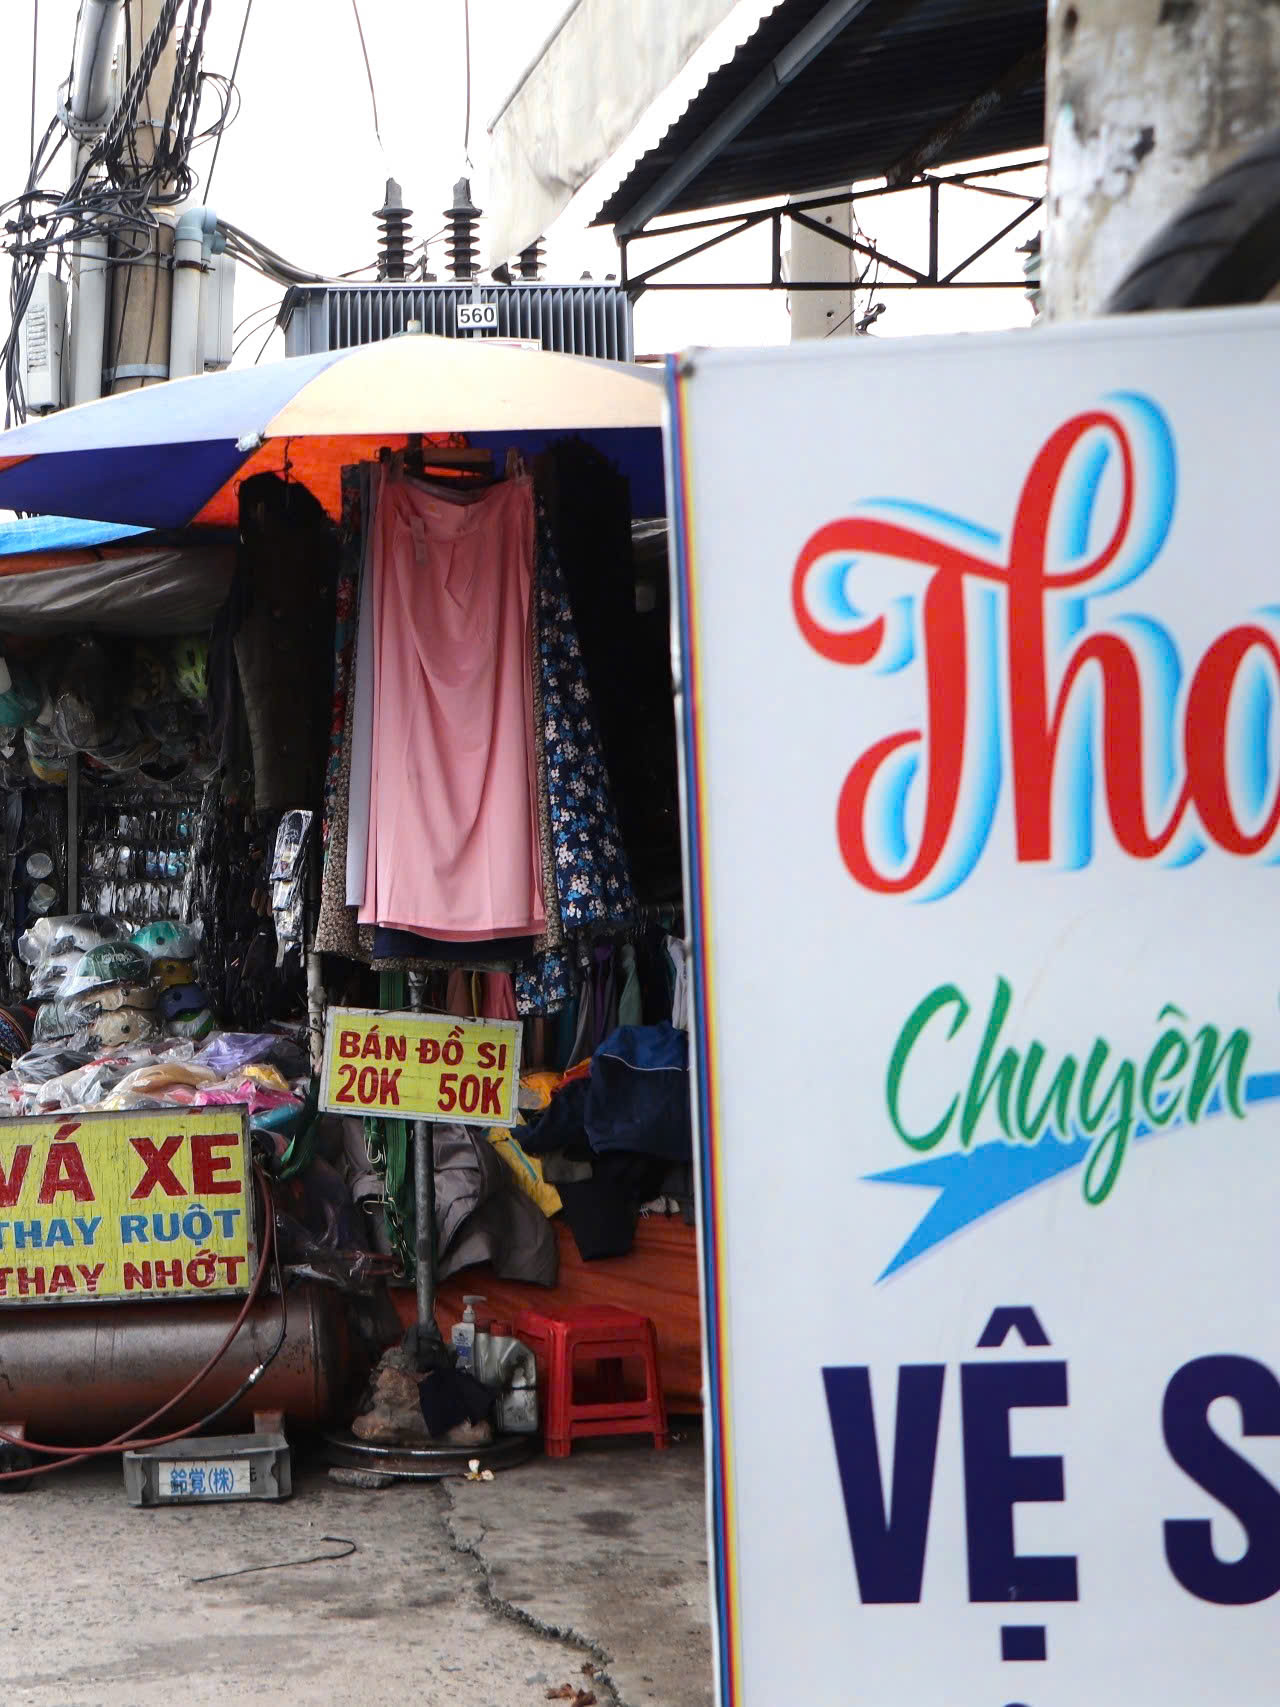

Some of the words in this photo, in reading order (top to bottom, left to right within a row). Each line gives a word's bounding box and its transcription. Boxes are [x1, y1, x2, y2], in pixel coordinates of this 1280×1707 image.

[460, 307, 495, 324] 560
[339, 1024, 407, 1062] BÁN
[415, 1025, 465, 1066] ĐỒ
[477, 1042, 507, 1071] SI
[336, 1064, 403, 1105] 20K
[438, 1073, 504, 1115] 50K
[886, 975, 1251, 1206] Chuyên
[129, 1133, 242, 1200] XE
[120, 1203, 241, 1246] RUỘT
[123, 1249, 246, 1290] NHỚT
[821, 1305, 1079, 1661] VỆ
